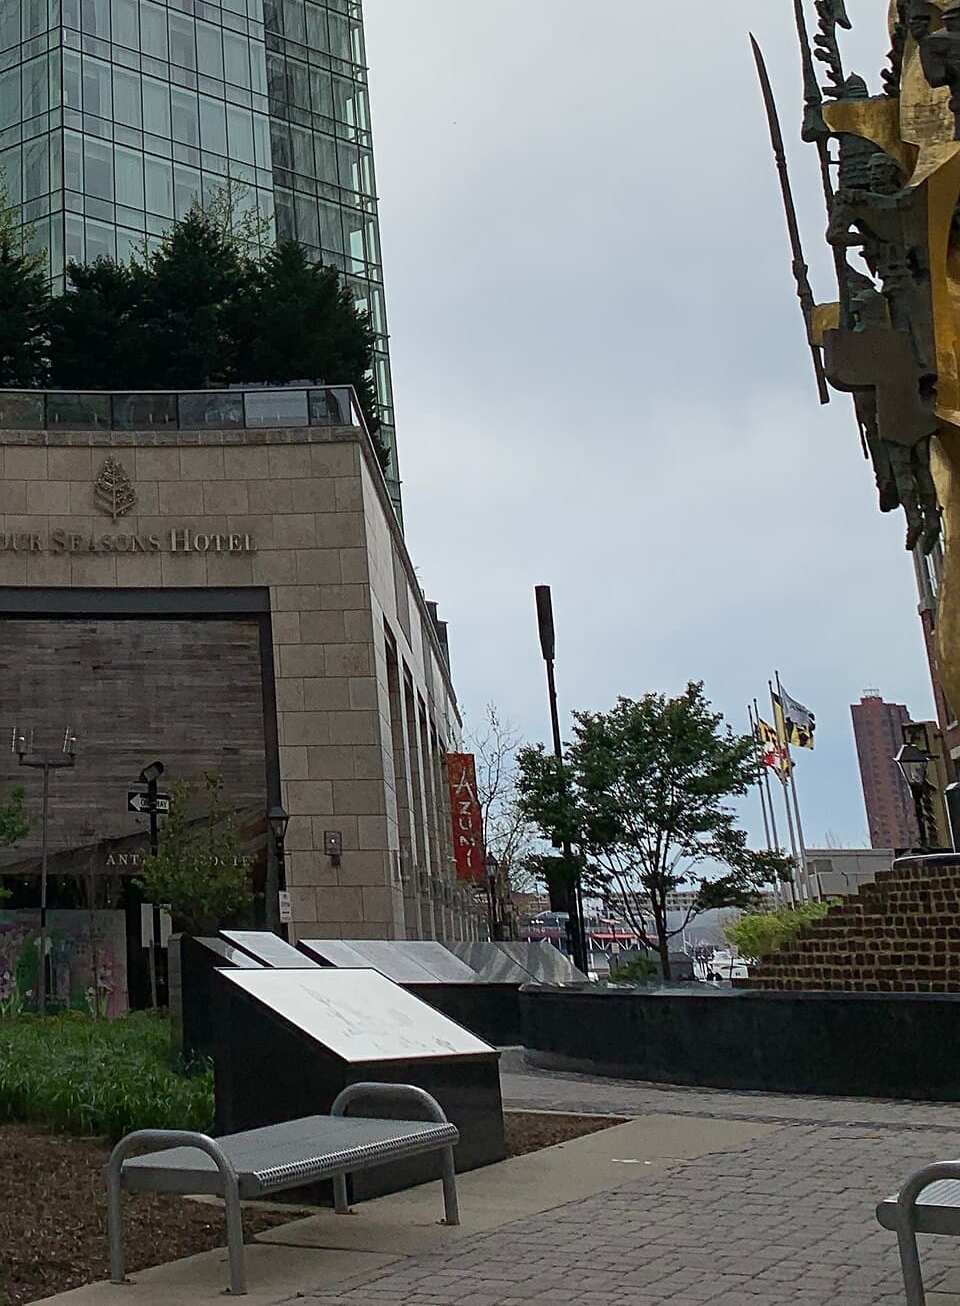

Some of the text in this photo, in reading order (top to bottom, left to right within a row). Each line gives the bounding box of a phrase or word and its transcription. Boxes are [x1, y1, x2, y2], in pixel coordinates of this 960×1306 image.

[52, 528, 161, 552] SEASONS
[169, 528, 257, 552] HOTEL
[451, 766, 478, 868] AZUMI
